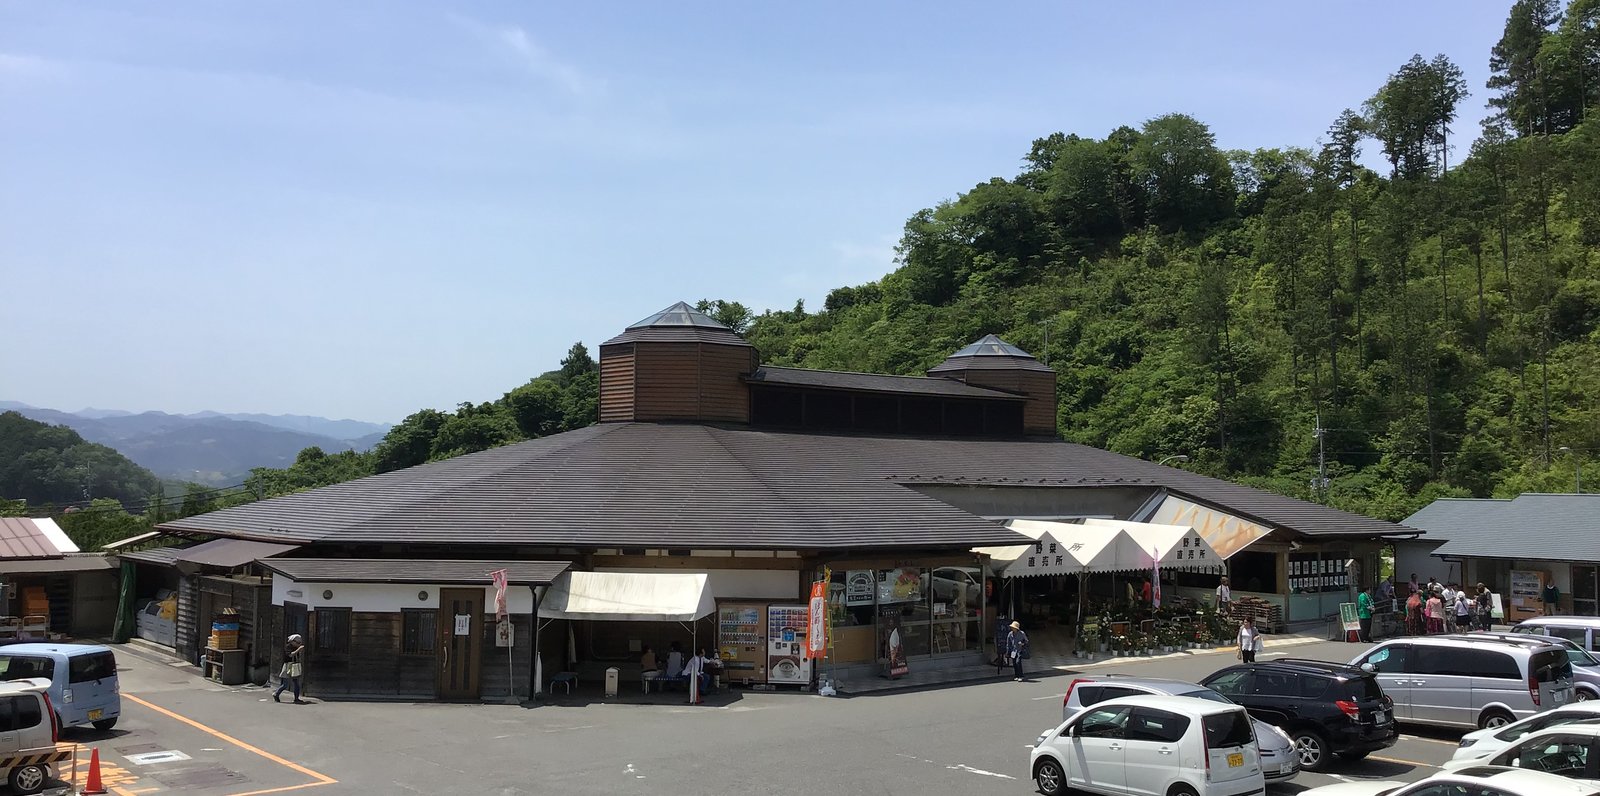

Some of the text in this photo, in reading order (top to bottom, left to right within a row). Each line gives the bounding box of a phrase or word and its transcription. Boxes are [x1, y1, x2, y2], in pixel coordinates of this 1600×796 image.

[1183, 538, 1200, 547] 野菜
[1036, 543, 1057, 554] 野菜
[1177, 549, 1205, 559] 直売所
[1028, 555, 1063, 567] 直売所
